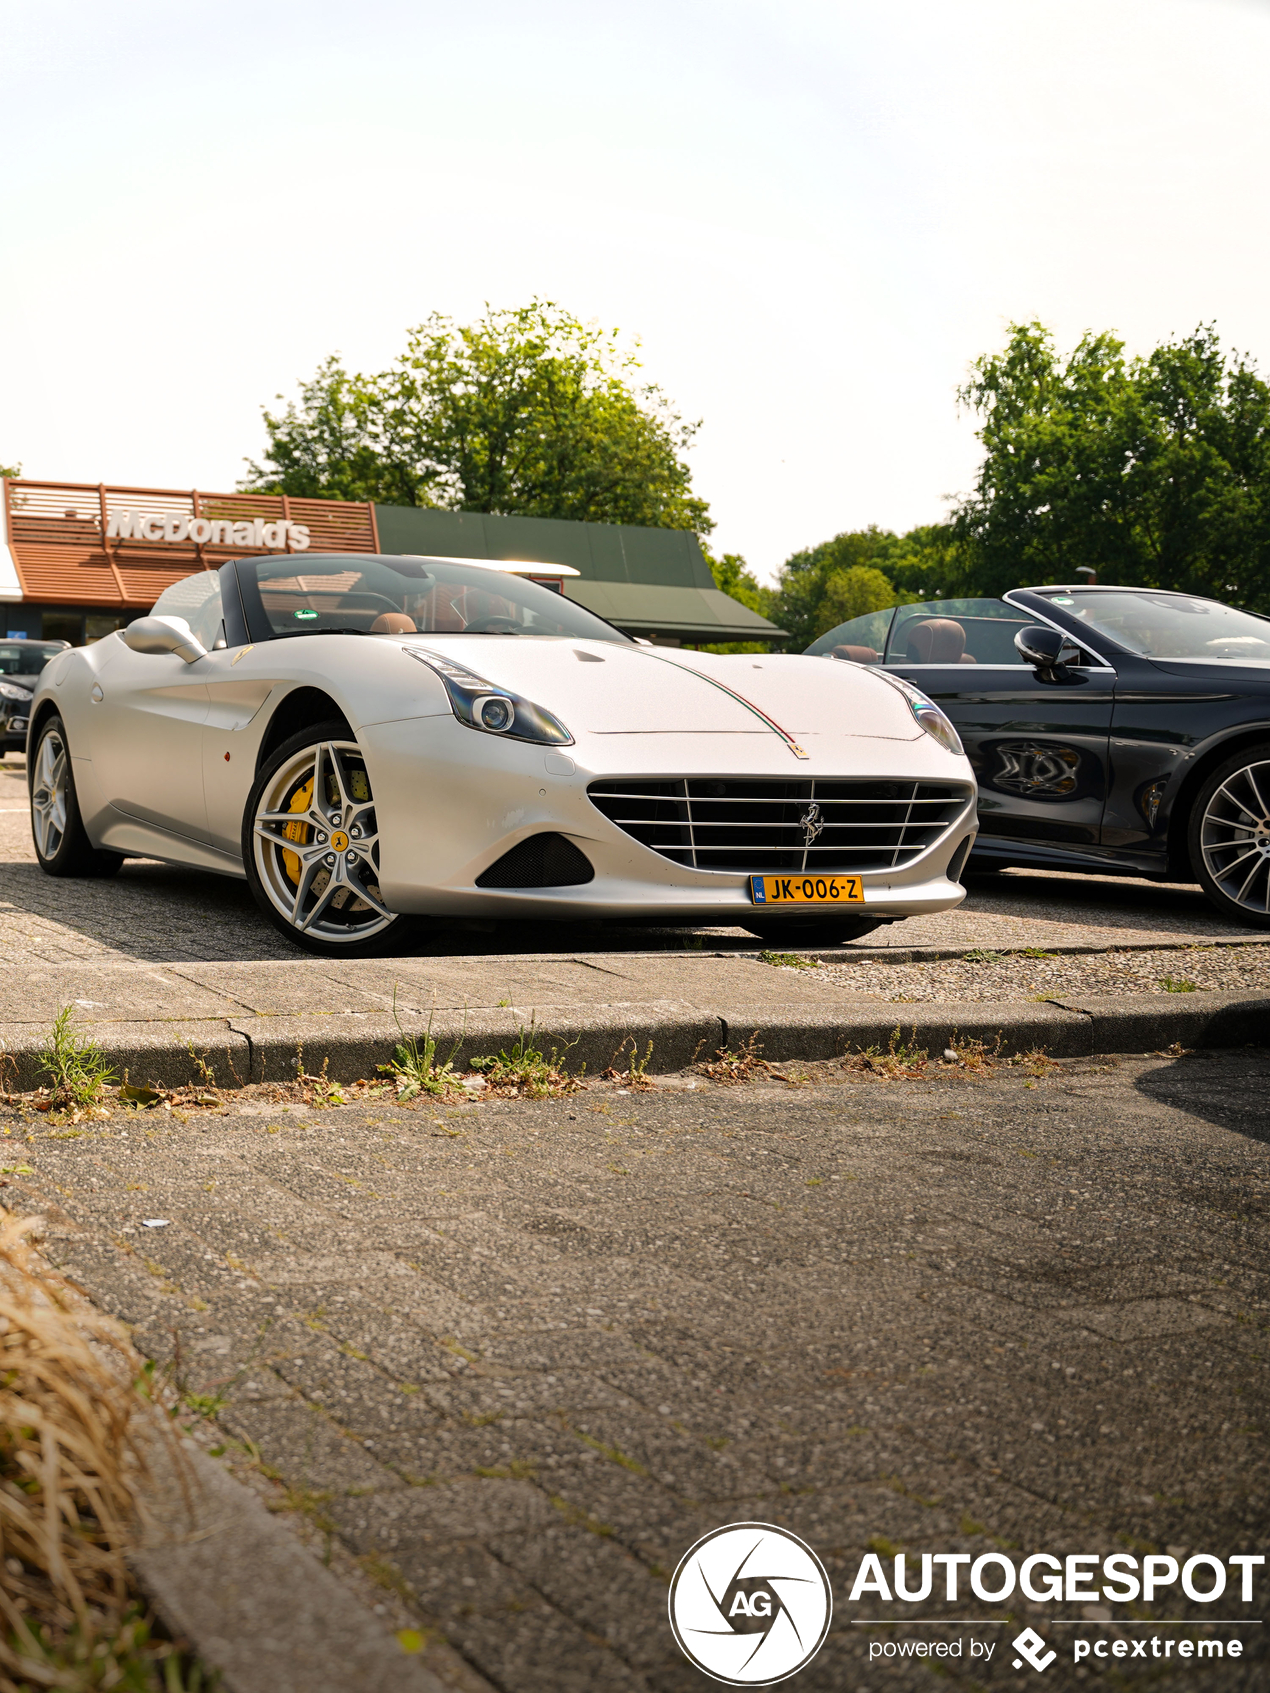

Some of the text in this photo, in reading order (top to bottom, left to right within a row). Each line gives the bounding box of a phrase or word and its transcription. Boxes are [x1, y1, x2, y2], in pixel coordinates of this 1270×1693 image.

[105, 508, 311, 550] McDonald's
[756, 891, 765, 899] NL
[771, 879, 858, 899] JK-006-Z
